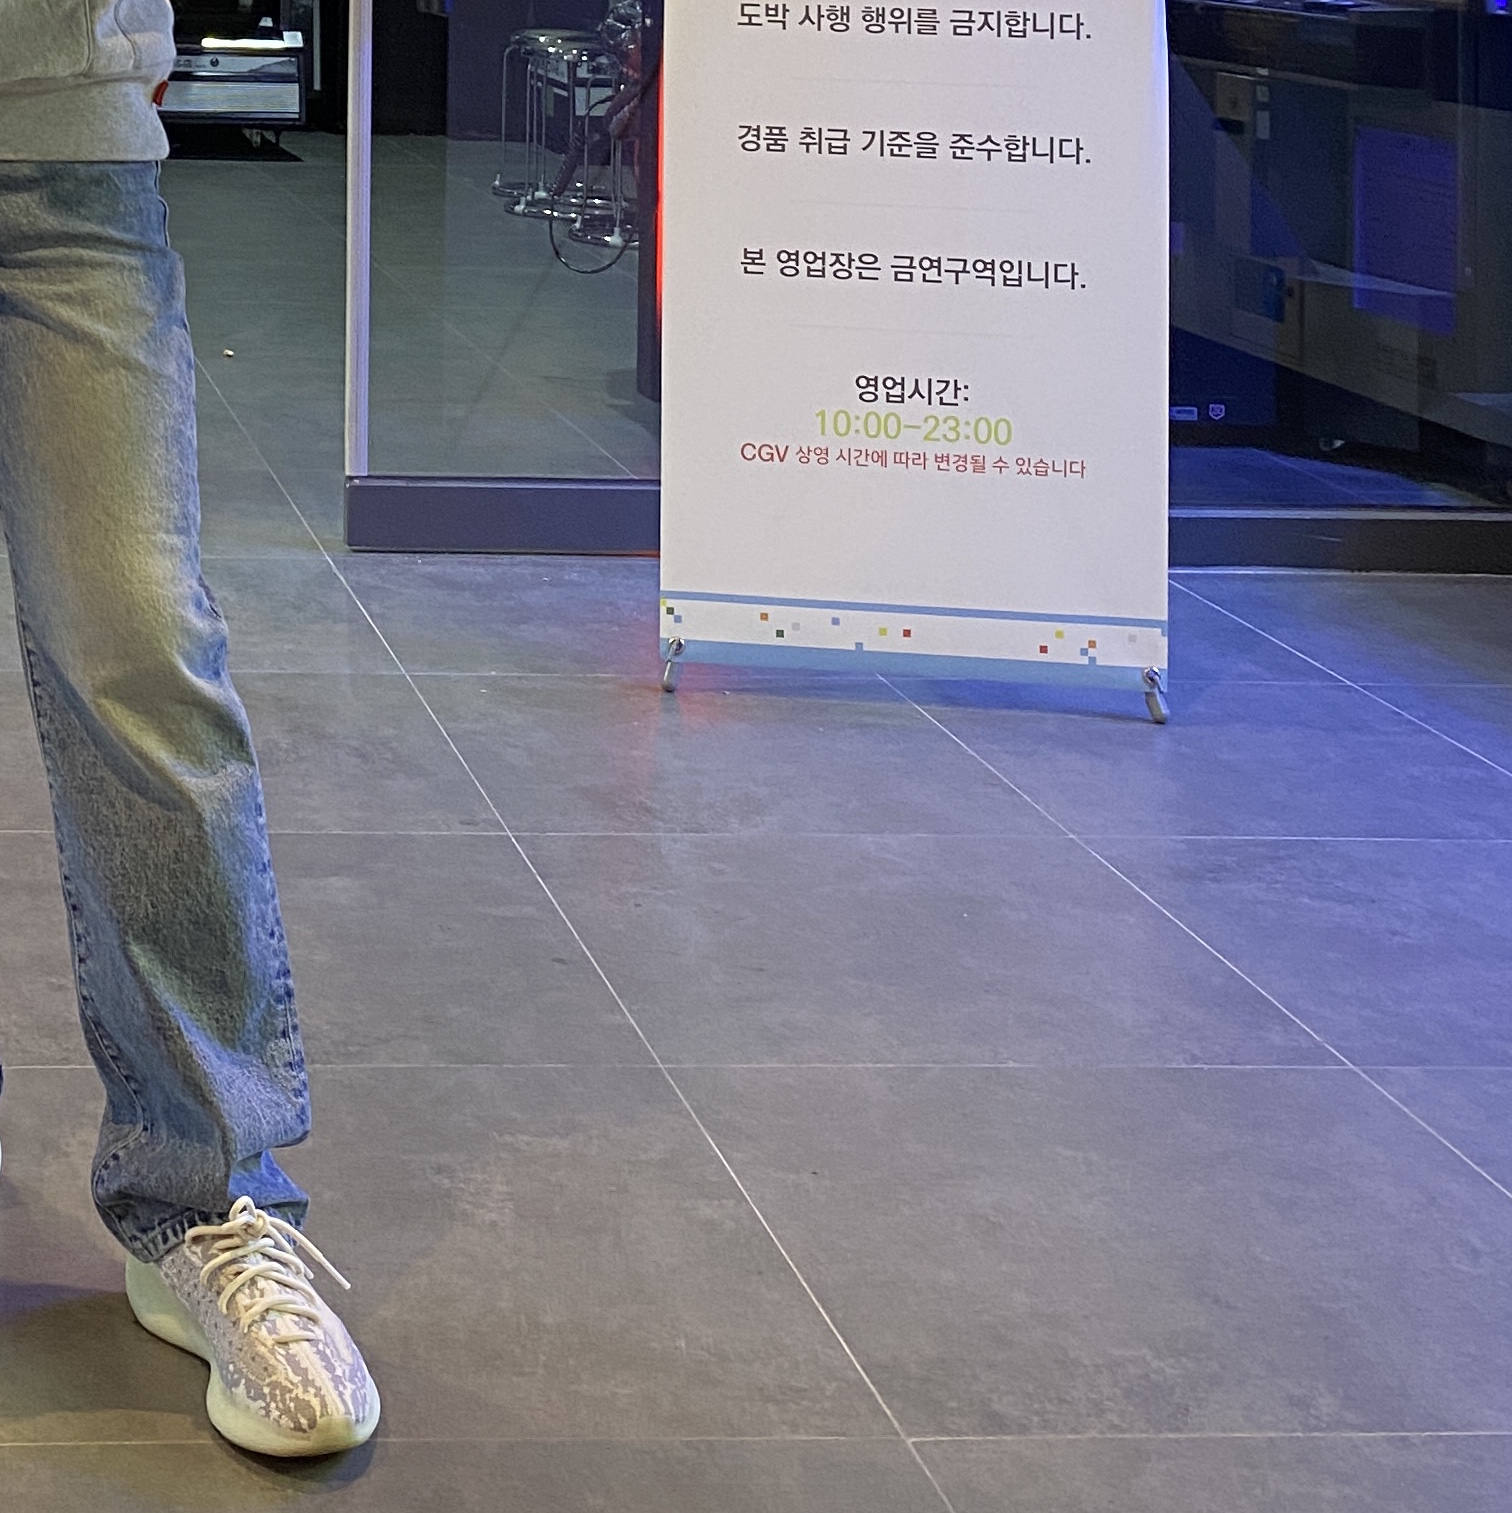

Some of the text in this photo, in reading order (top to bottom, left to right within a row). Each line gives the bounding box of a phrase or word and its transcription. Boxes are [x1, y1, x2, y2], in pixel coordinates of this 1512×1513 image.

[737, 3, 1091, 40] 도박 사행 행위를 금지합니다.
[738, 124, 1091, 165] 경품 취급 기준을 준수합니다.
[740, 248, 1086, 290] 본 영업장은 금연구역입니다.
[854, 374, 968, 407] 영업시간:
[816, 410, 1012, 446] 10:00-23:00
[741, 443, 1086, 479] CGV 상영 시간에 따라 변경될 수 있습니다
